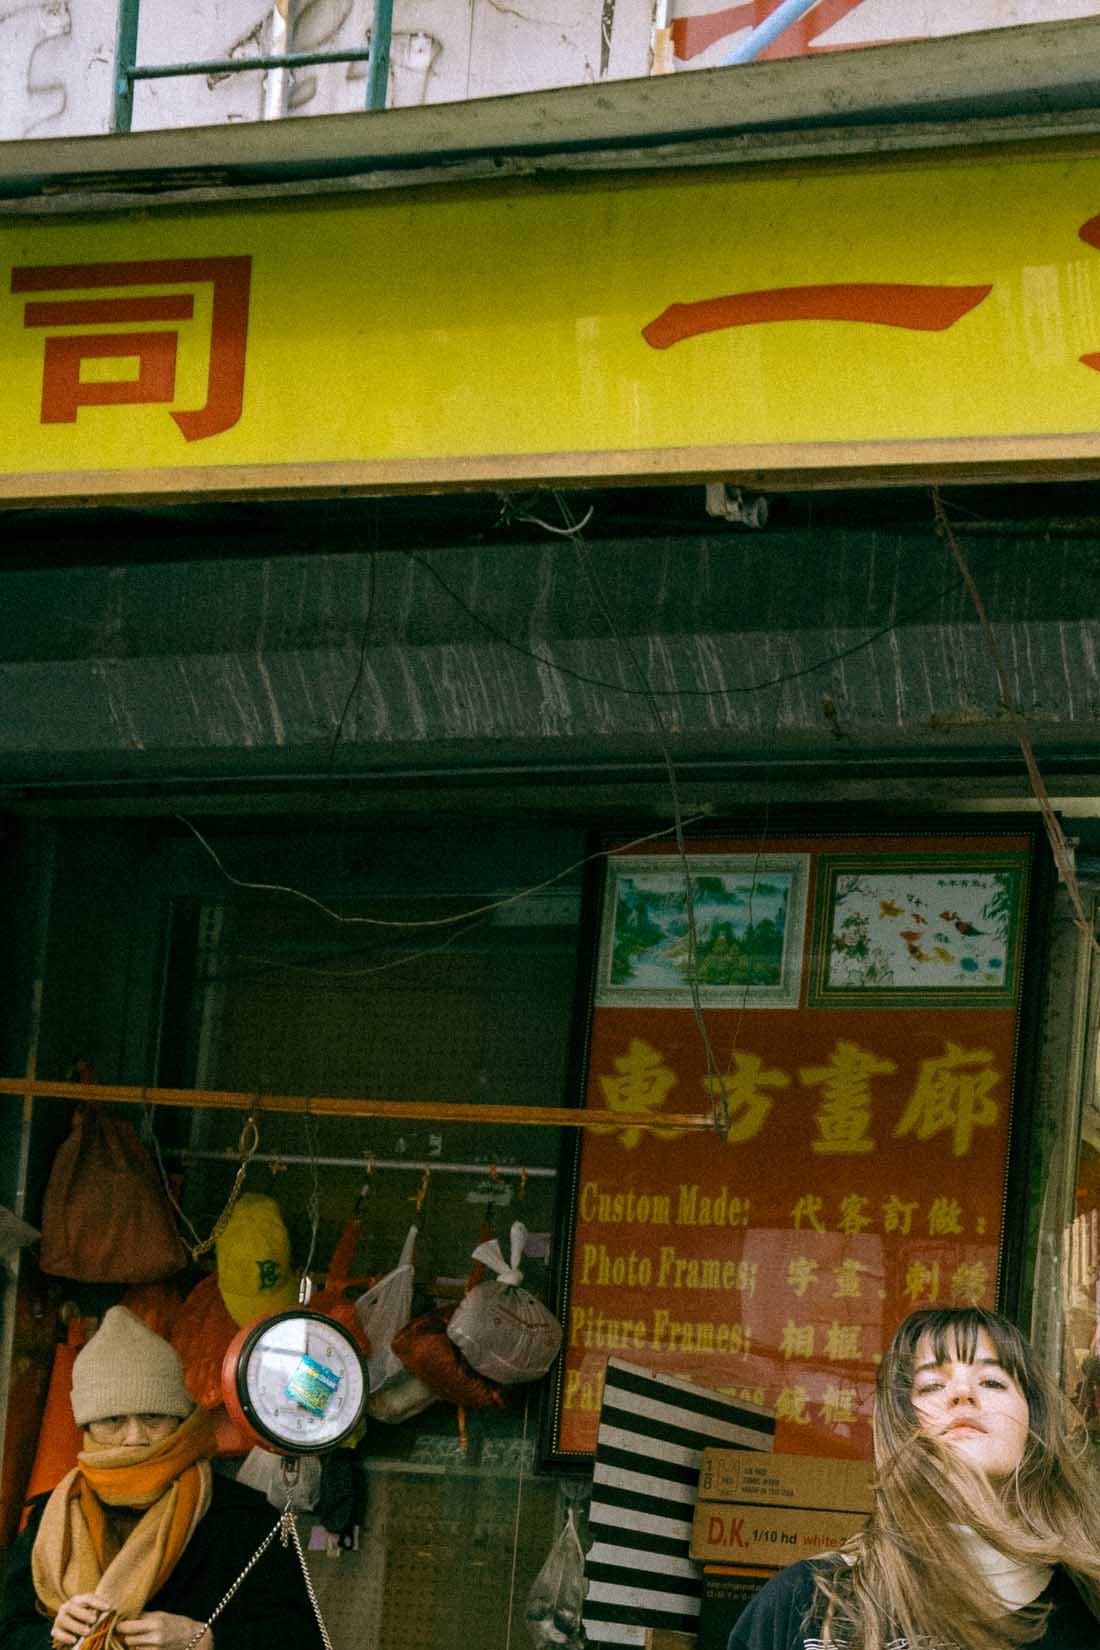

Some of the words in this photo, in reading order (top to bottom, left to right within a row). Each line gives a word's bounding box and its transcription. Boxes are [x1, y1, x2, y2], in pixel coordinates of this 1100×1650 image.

[10, 255, 252, 443] 司
[581, 1182, 670, 1226] Custom
[581, 1245, 652, 1286] Photo
[571, 1307, 646, 1349] Piture
[707, 1516, 749, 1549] D.K.
[752, 1529, 777, 1543] 1/10
[780, 1527, 797, 1545] hd
[802, 1534, 837, 1547] white
